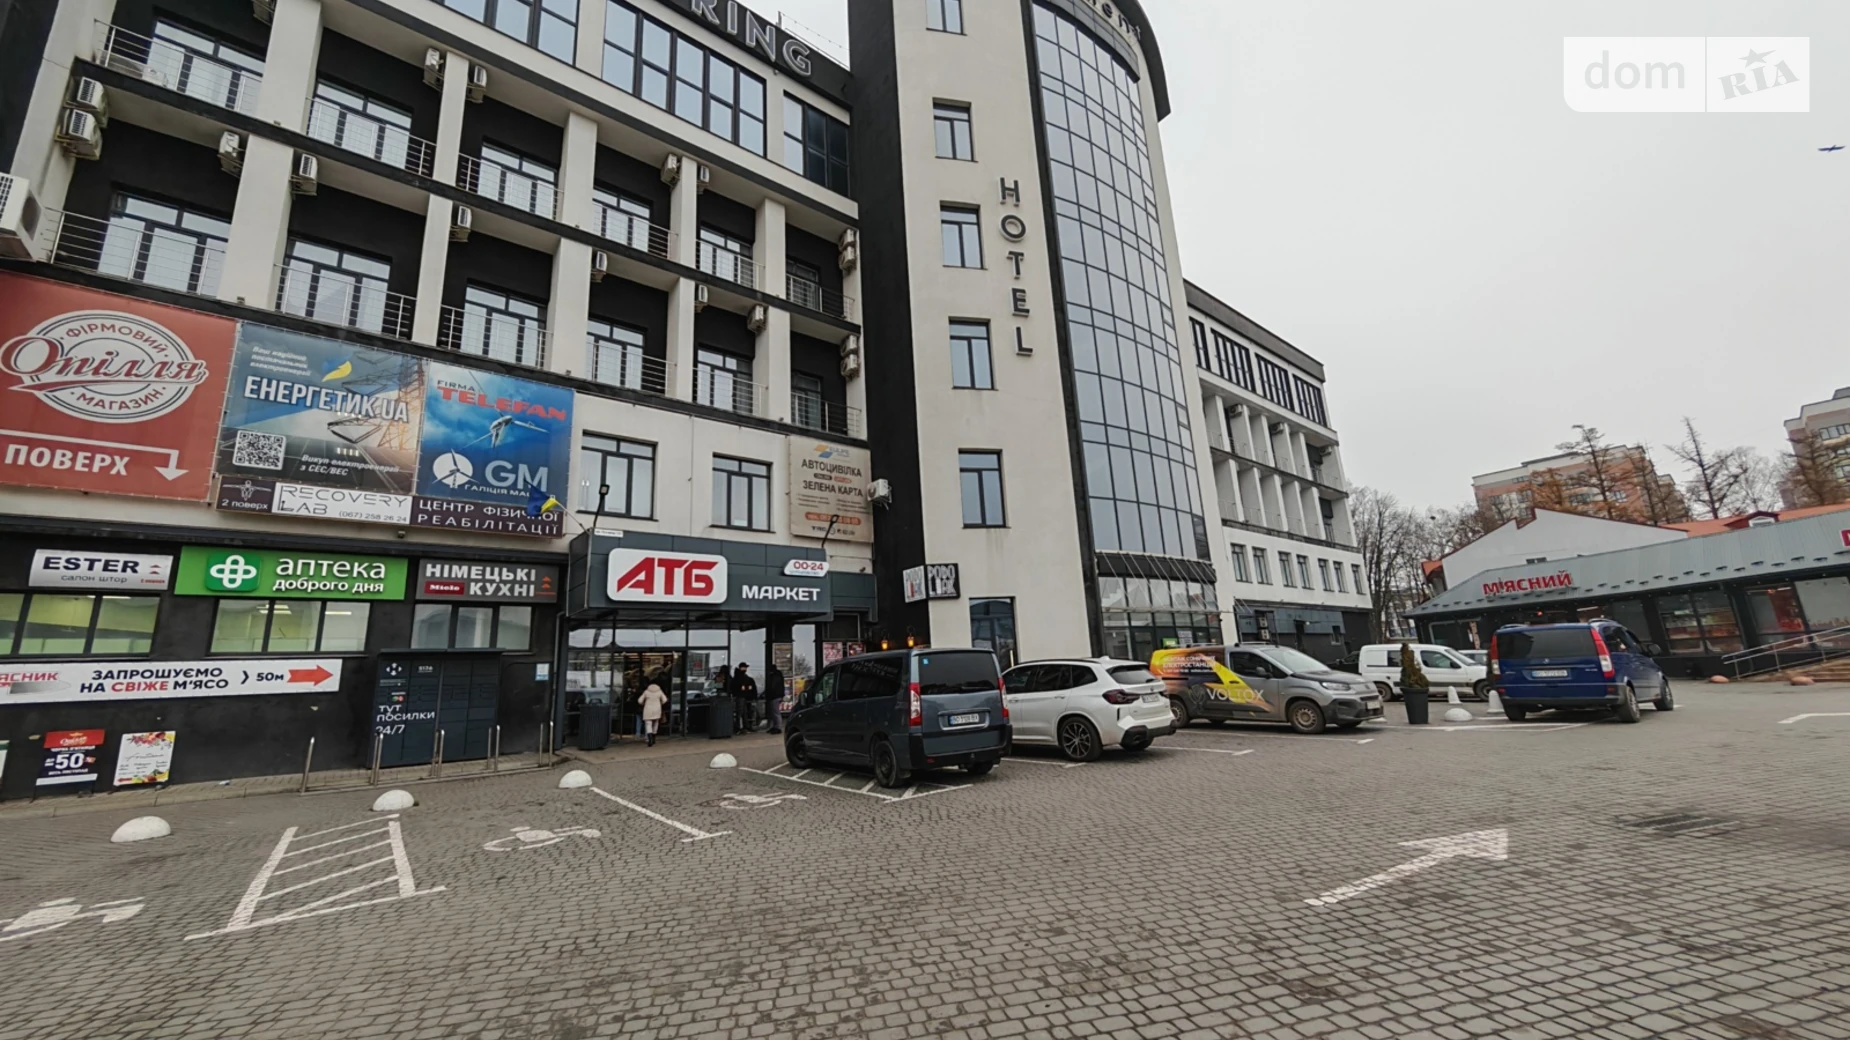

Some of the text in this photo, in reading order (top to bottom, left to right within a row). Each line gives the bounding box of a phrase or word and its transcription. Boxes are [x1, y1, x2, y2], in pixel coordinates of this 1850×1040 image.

[999, 177, 1033, 356] HOTEL
[66, 323, 168, 353] ФІРМОВИЙ
[1, 336, 208, 383] Опілля
[437, 380, 476, 392] FIRMA
[76, 388, 163, 411] МАГАЗИН
[244, 375, 408, 423] ЕНЕРГЕТИК UA
[437, 386, 566, 420] TELEFAN
[5, 444, 130, 476] ПОВЕРХ
[801, 459, 862, 477] АВТОЦИВІЛКА
[485, 460, 549, 492] GM
[280, 485, 408, 507] RECOVERY
[803, 480, 863, 497] ЗЕЛЕНА КАРТА
[221, 499, 269, 511] 2 поверх
[280, 501, 328, 515] LAB
[419, 499, 475, 513] ЦЕНТР
[417, 514, 559, 535] РЕАБІЛІТАЦІЇ
[43, 556, 140, 574] ESTER
[276, 558, 385, 579] аптека
[425, 563, 536, 582] НІМЕЦЬКІ
[272, 577, 384, 594] доброго дня
[616, 557, 719, 597] АТБ
[469, 582, 535, 597] КУХНІ
[741, 585, 820, 601] МАРКЕТ
[92, 667, 223, 681] ЗАПРОШУЄМО
[79, 682, 106, 693] НА
[111, 680, 169, 692] СВІЖЕ
[1206, 688, 1265, 700] VOLTOX
